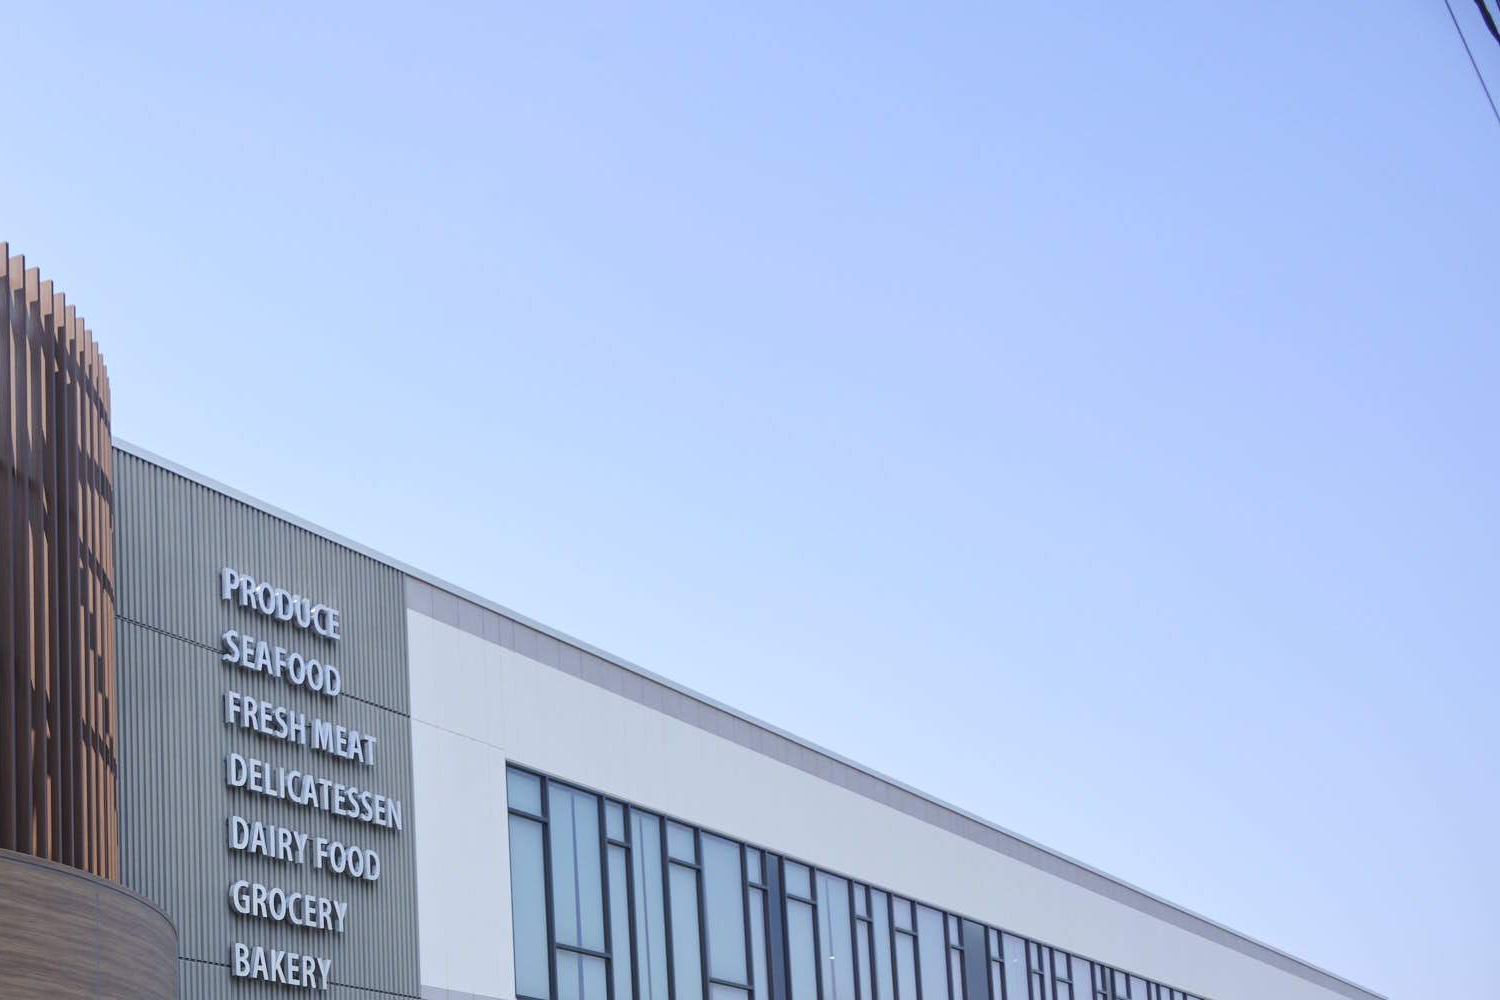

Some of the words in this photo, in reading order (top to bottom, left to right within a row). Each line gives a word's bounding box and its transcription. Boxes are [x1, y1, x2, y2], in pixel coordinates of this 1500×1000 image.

[221, 567, 341, 641] PRODUCE
[222, 630, 342, 697] SEAFOOD
[225, 691, 306, 744] FRESH
[311, 718, 377, 766] MEAT
[226, 753, 403, 831] DELICATESSEN
[228, 815, 308, 864] DAIRY
[313, 837, 381, 881] FOOD
[229, 880, 348, 933] GROCERY
[230, 943, 332, 991] BAKERY
